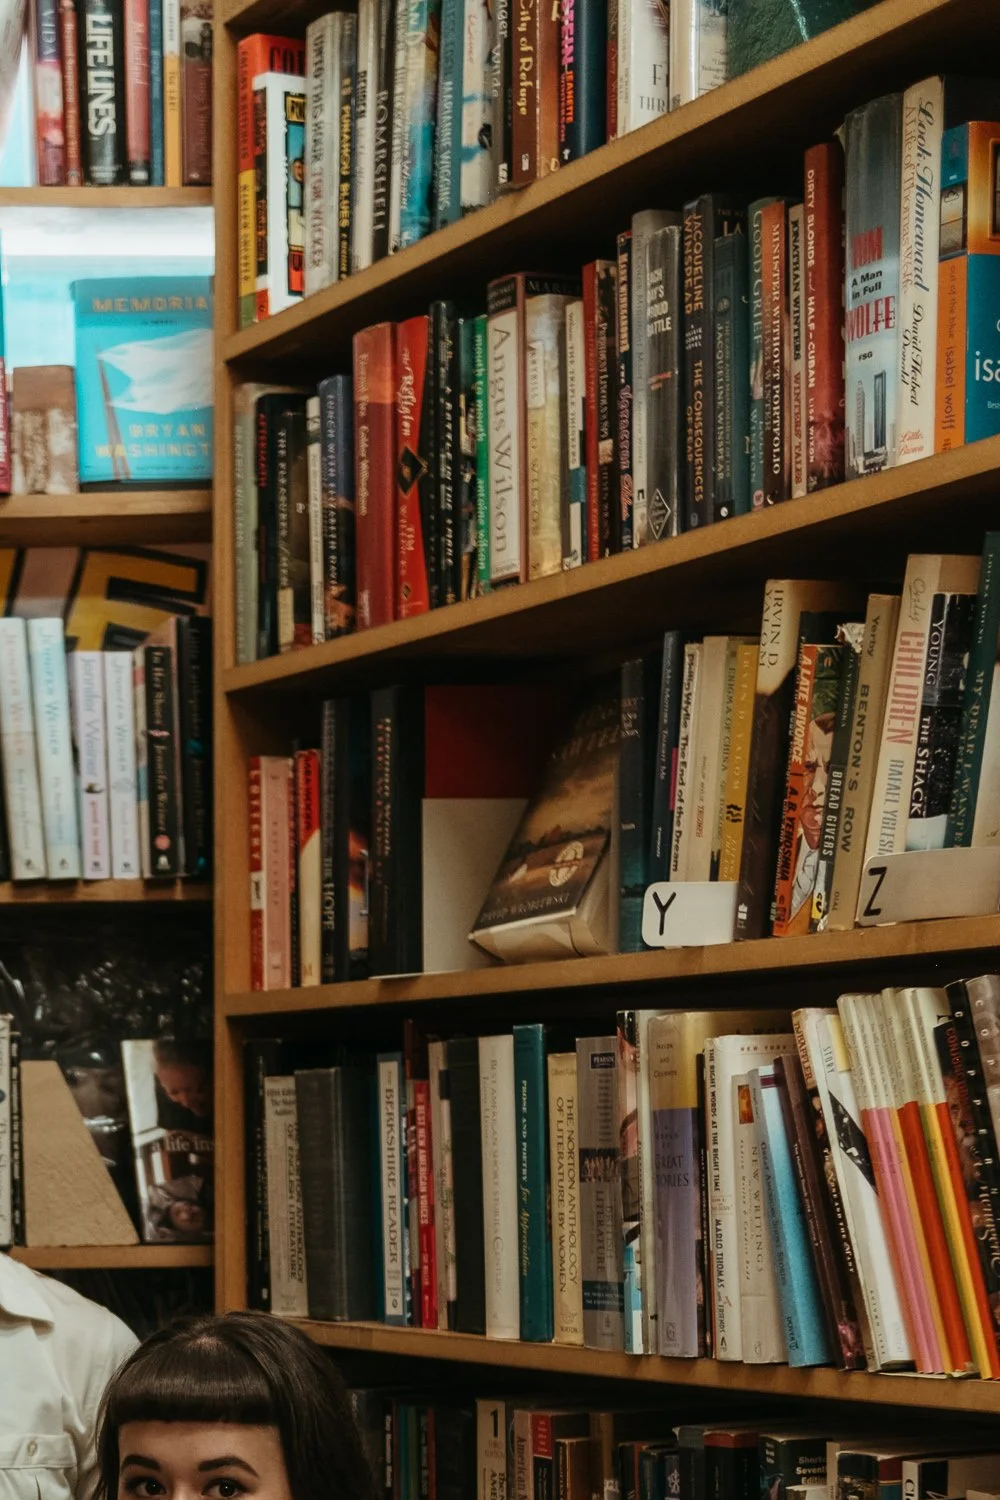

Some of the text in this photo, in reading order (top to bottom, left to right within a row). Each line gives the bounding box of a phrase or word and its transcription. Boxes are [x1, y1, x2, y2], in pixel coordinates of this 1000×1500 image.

[43, 9, 56, 62] VIDAL
[86, 14, 116, 136] LIFE LINES
[516, 57, 533, 116] Refuge
[520, 38, 533, 51] of
[439, 81, 452, 211] MARIANNE WIGGINS
[565, 71, 573, 123] JEANETTE
[339, 183, 350, 228] BLUES
[373, 90, 388, 232] BOMBSHELL
[912, 97, 935, 293] Look Homeward
[683, 213, 704, 315] JACQUELINE WINSPEAR
[771, 223, 782, 475] MINISTER WITHOUT PORTFOLIO
[909, 303, 924, 406] David Herbert
[942, 345, 957, 430] isabel wolff
[129, 424, 205, 437] BRYAN
[489, 327, 513, 553] Angus Wilson
[694, 360, 704, 502] THE CONSEQUENCES
[715, 323, 725, 482] JACQUELINE WINSPEAR
[808, 426, 816, 463] WIXON
[767, 589, 785, 670] IRVIN D.
[865, 615, 880, 658] Yerby
[924, 619, 944, 687] YOUNG
[82, 657, 100, 778] Jennifer Weiner
[791, 655, 812, 765] A LATE DIVORCE
[885, 631, 924, 745] CHILDREN
[155, 744, 169, 831] Jennifer Weiner
[249, 770, 260, 860] LOTTERY
[671, 734, 689, 872] The End of the Dream
[821, 770, 843, 857] BREAD GIVERS
[840, 683, 870, 853] BENTON'S ROW
[909, 715, 931, 817] THE SHACK
[651, 891, 677, 936] Y
[862, 867, 889, 918] Z
[286, 1123, 298, 1281] OF ENGLISH LITERATURE
[555, 1097, 567, 1293] OF LITERATURE BY WOMEN
[566, 1096, 578, 1285] THE NORTON ANTHOLOGY
[594, 1190, 606, 1274] LITERATURE
[516, 1436, 529, 1491] American
